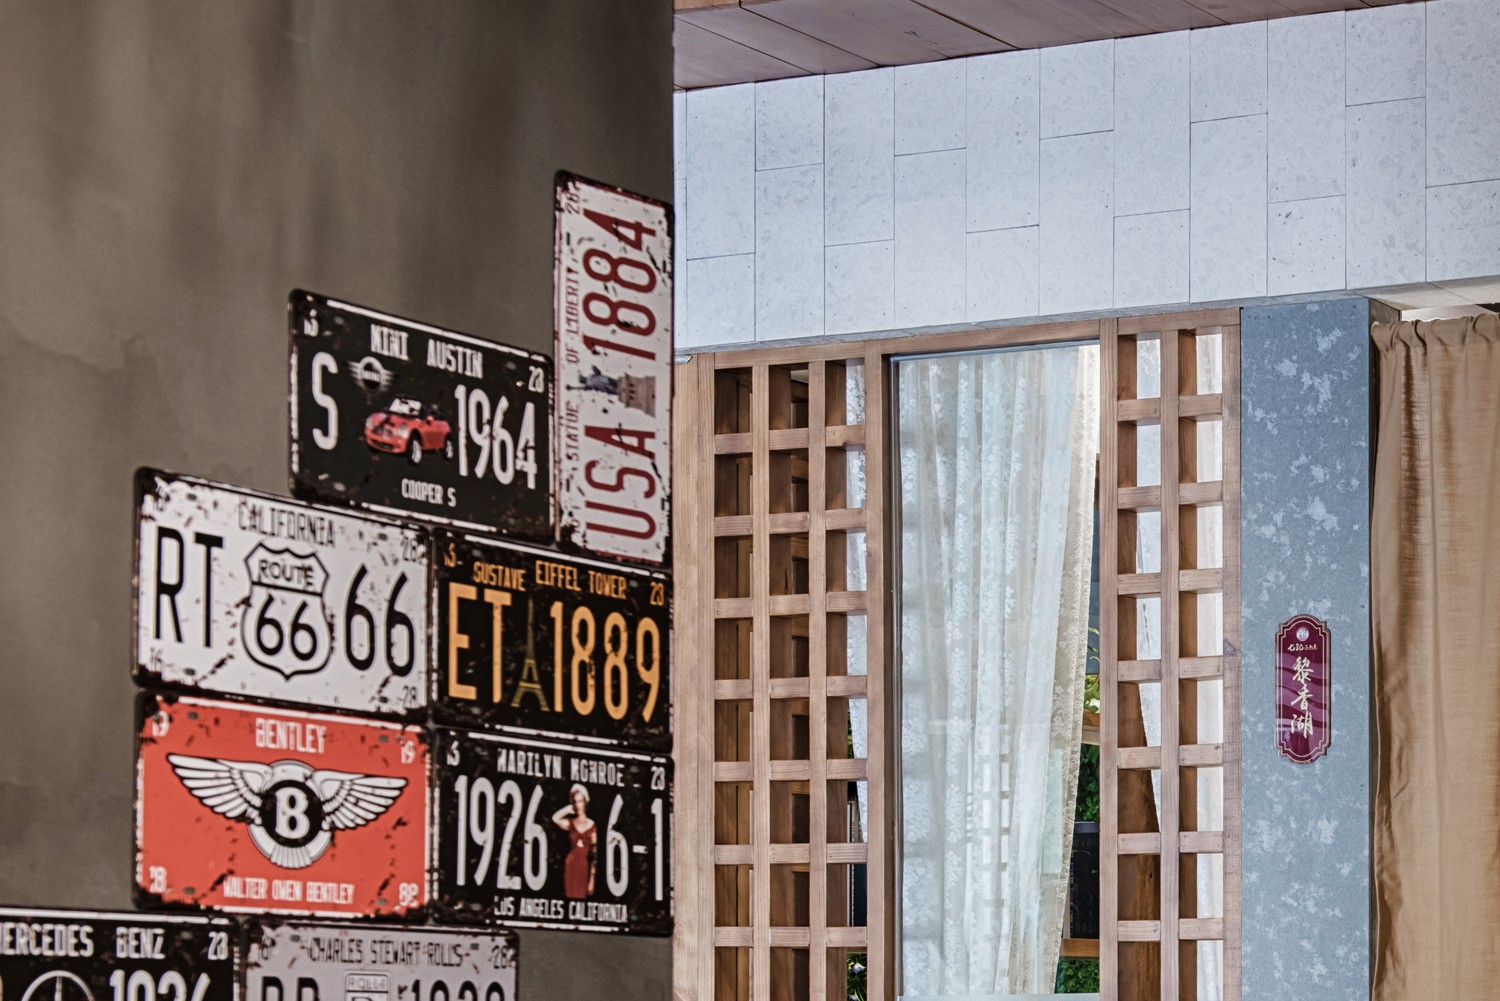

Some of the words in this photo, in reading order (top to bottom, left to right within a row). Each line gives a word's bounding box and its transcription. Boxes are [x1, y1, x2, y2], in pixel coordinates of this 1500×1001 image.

[566, 266, 580, 336] LIBERTY
[582, 208, 657, 361] 1884
[371, 323, 409, 361] MINI
[426, 338, 483, 379] AUSTIN
[566, 343, 580, 364] OF
[311, 351, 339, 451] S
[454, 384, 538, 490] 1964
[566, 400, 580, 462] STATUE
[402, 478, 443, 505] COOPER
[447, 487, 457, 508] S
[584, 425, 656, 540] USA
[237, 501, 335, 548] CALIFORNIA
[153, 525, 223, 648] RT
[344, 563, 415, 677] 66
[258, 558, 315, 588] ROUTE
[535, 560, 581, 592] EIFFEL
[588, 570, 627, 600] TOWER
[256, 594, 318, 661] 66
[448, 581, 512, 704] ET
[550, 600, 661, 723] 1889
[1291, 656, 1314, 739] 黎香湖
[255, 717, 327, 753] BENTLEY
[497, 747, 562, 779] MARILYN
[570, 757, 625, 787] MONROE
[274, 786, 310, 839] B
[454, 774, 548, 891] 1926
[223, 876, 268, 899] WALTER
[271, 879, 303, 902] OWEN
[306, 881, 355, 904] BENTLEY
[494, 896, 515, 916] LOS
[519, 897, 564, 919] ANGELES
[568, 901, 628, 922] CALIFORNIA
[0, 922, 94, 957] ERCEDES
[116, 926, 166, 960] BENZ
[309, 938, 362, 963] CHARLES
[371, 940, 420, 965] STEWART
[427, 942, 463, 967] ROLLS
